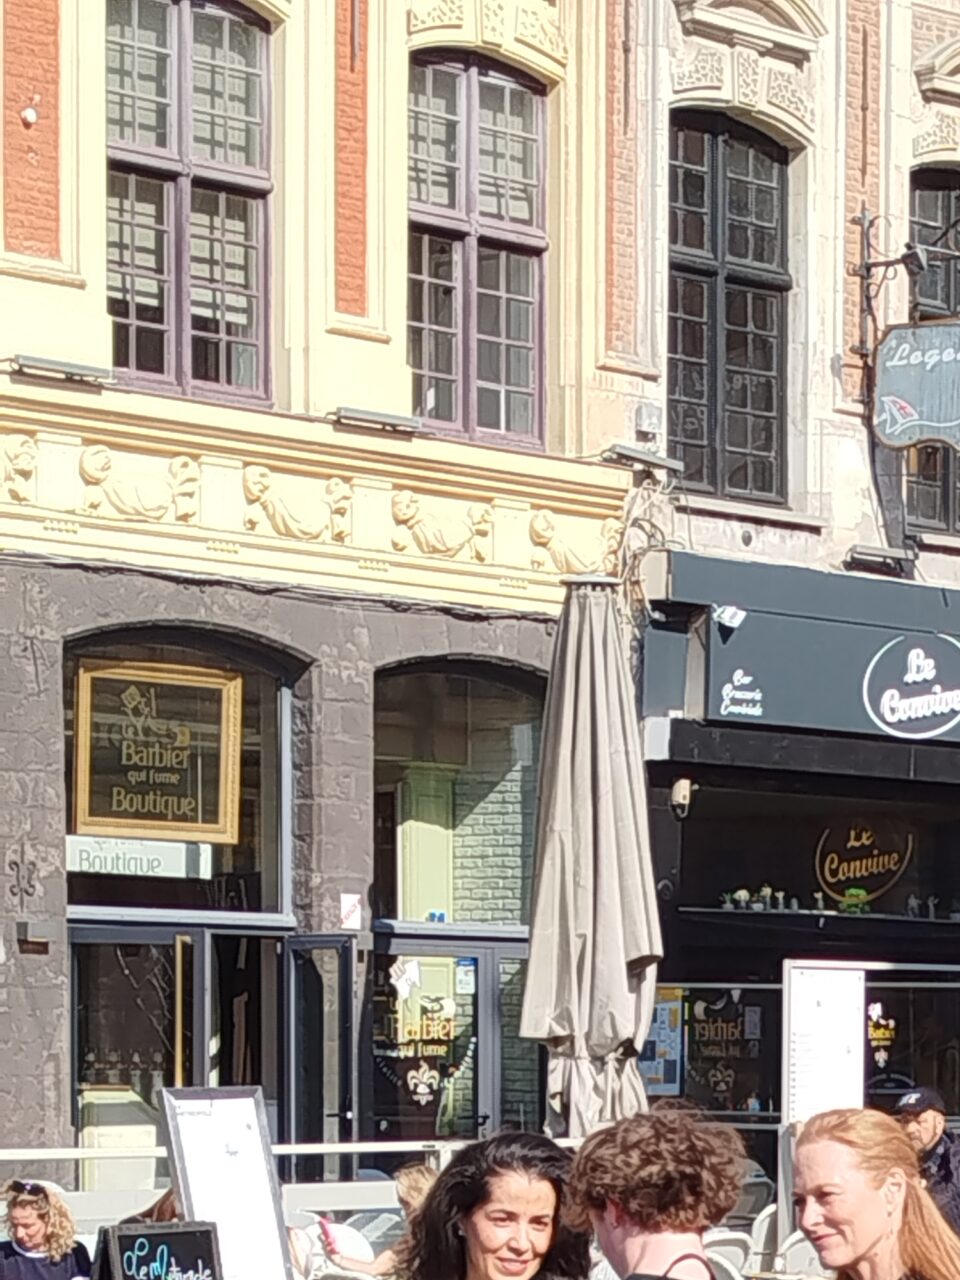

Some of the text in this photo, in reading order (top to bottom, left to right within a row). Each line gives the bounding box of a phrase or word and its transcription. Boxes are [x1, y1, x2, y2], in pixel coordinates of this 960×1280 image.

[903, 648, 936, 683] Le
[121, 741, 191, 769] Barbier
[127, 769, 180, 785] qui fume
[112, 786, 196, 820] Boutique
[846, 824, 874, 848] Le
[79, 849, 162, 874] Boutique
[824, 848, 900, 883] Convive
